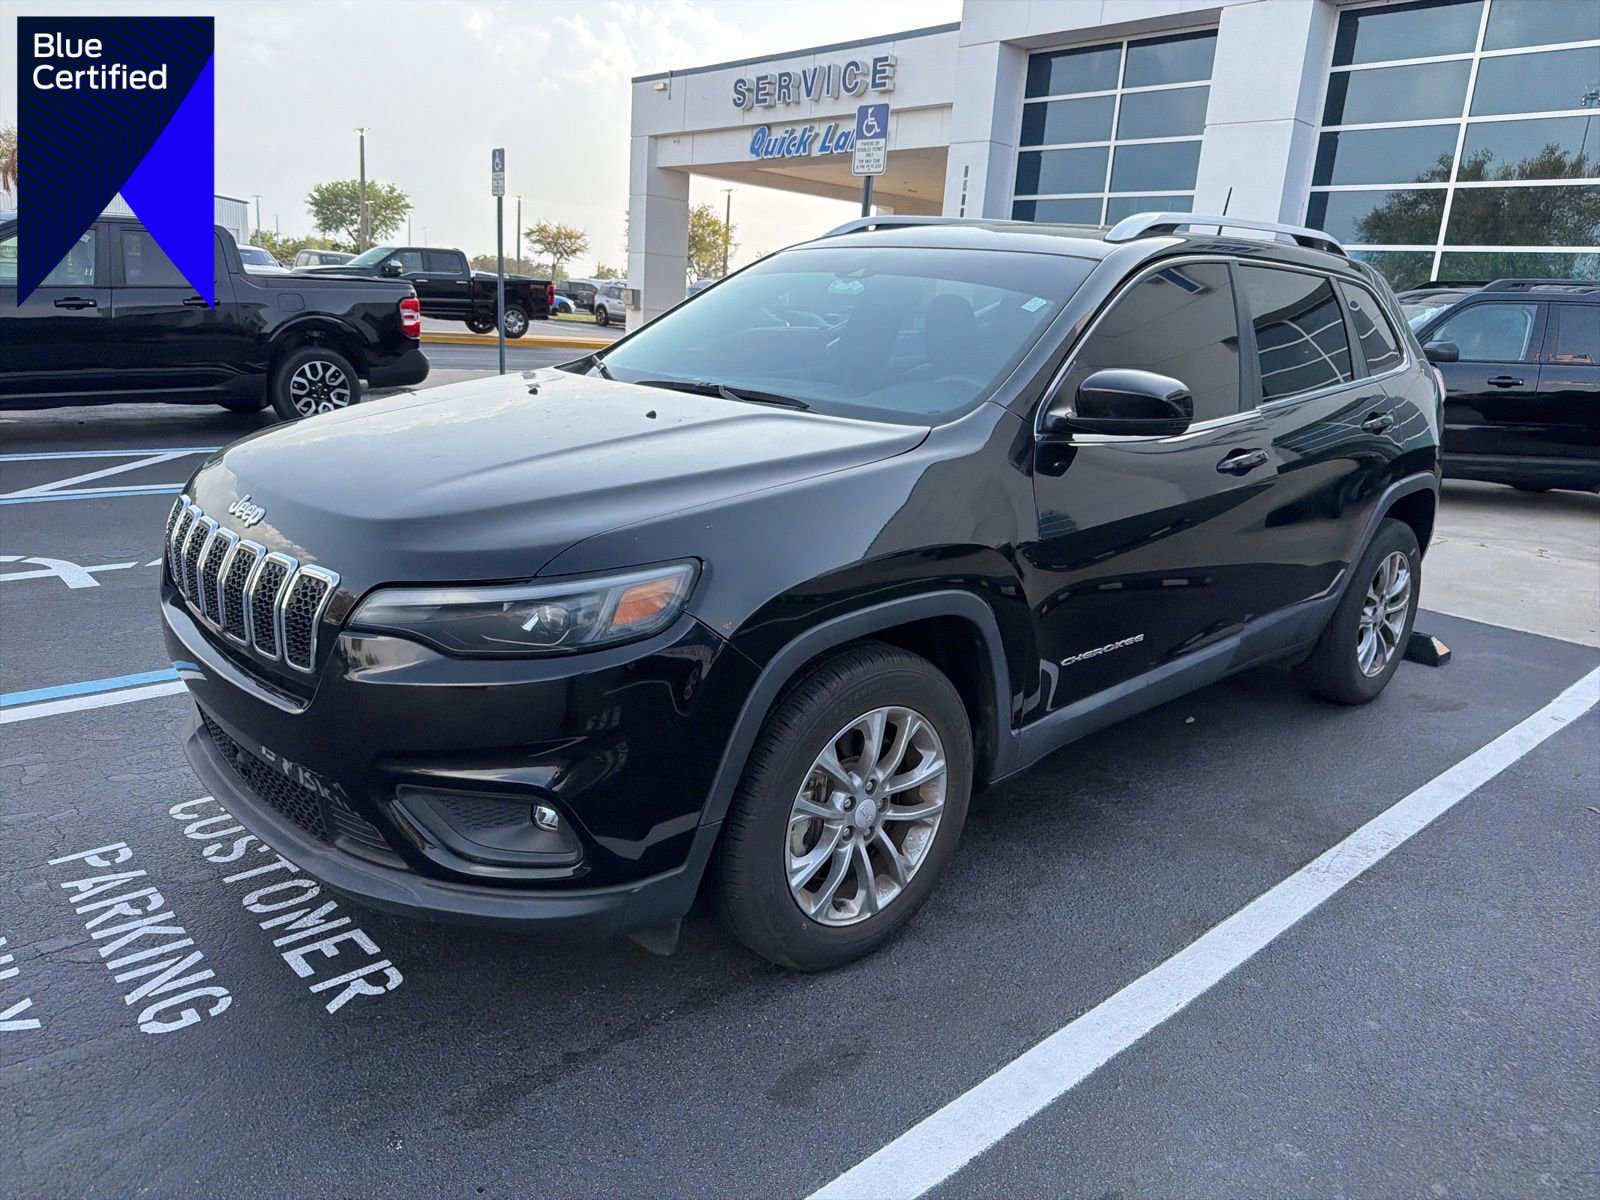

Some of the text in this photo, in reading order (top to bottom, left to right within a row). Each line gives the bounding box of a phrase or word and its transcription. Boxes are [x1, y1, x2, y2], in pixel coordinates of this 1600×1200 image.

[732, 55, 897, 111] SERVICE
[750, 122, 855, 160] Quick La
[229, 495, 265, 527] Jeep
[1061, 634, 1144, 666] CHEROKEE
[168, 796, 404, 1014] CUSTOMER
[48, 842, 233, 1034] PARKING
